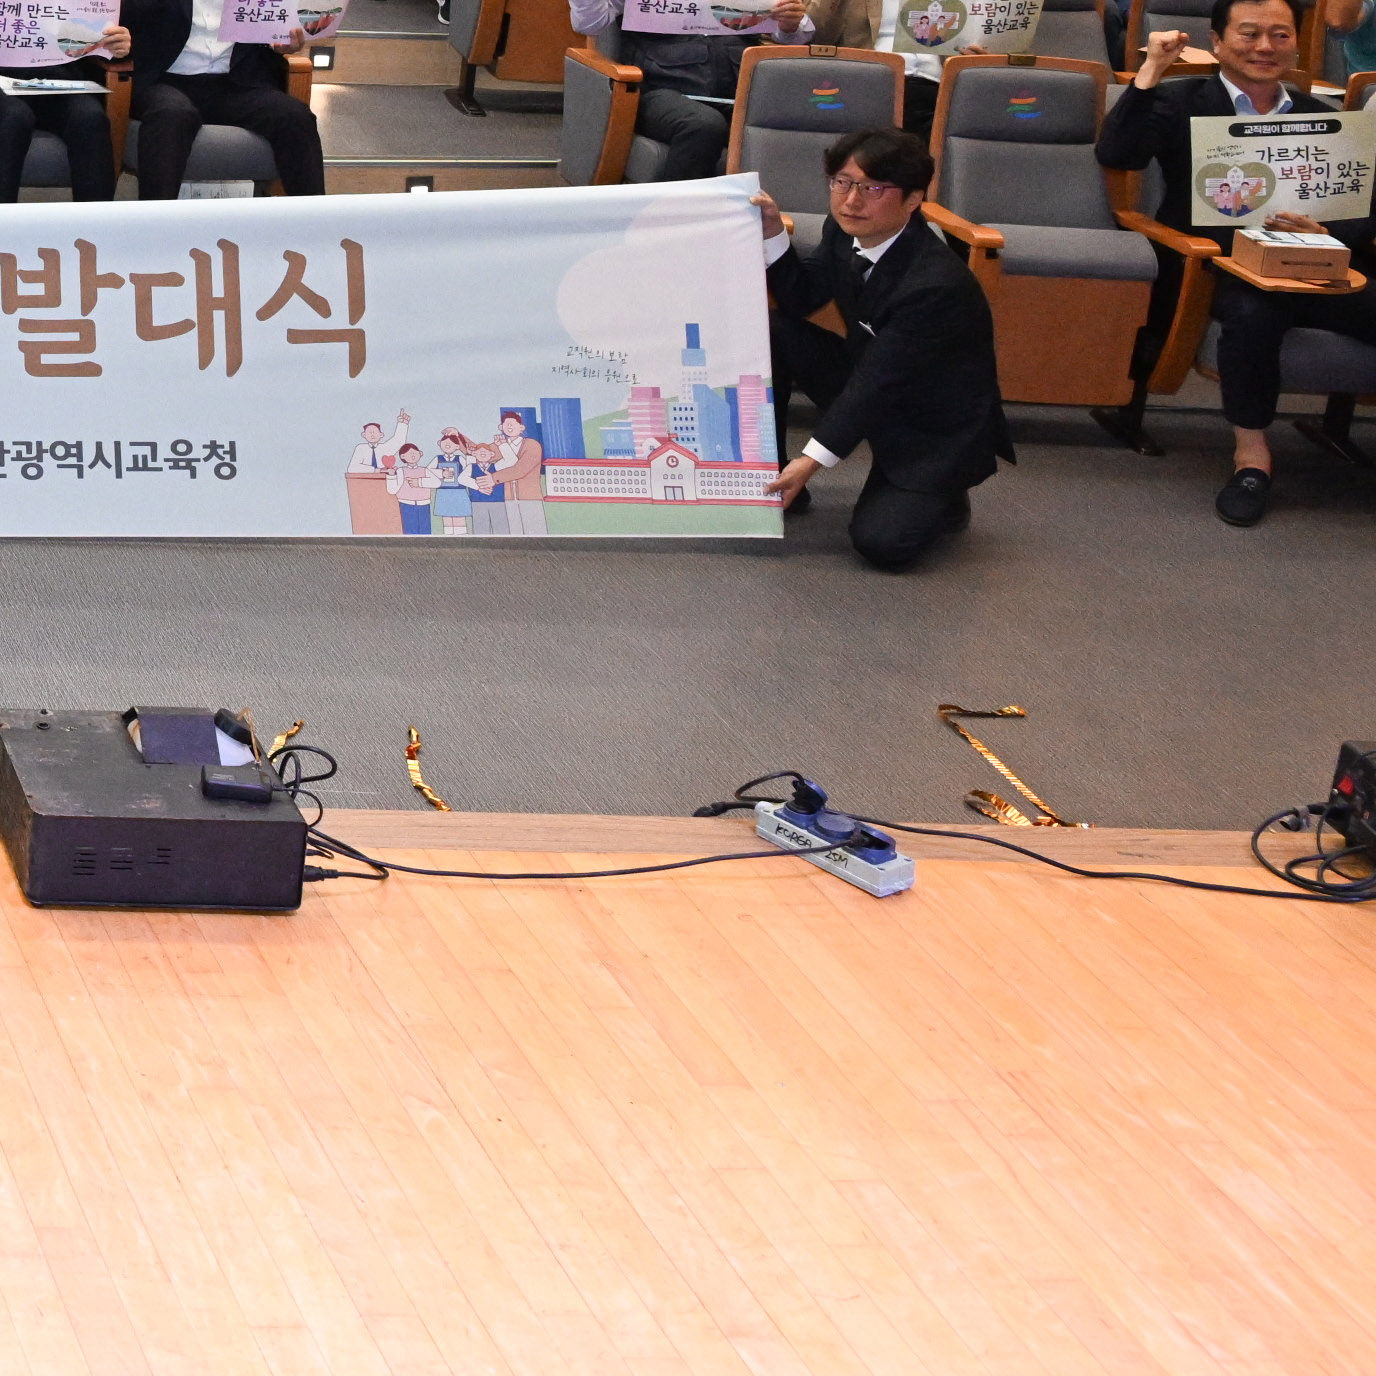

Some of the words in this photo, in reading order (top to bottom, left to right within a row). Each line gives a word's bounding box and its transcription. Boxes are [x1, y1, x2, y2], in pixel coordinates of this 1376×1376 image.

[1243, 124, 1280, 134] 교직원이
[1281, 122, 1327, 133] 함께합니다
[1255, 145, 1329, 165] 가르치는
[1277, 163, 1330, 180] 보람이
[1336, 160, 1370, 178] 있는
[1295, 178, 1364, 200] 울산교육
[566, 345, 604, 359] 교직원의
[609, 350, 628, 364] 보람
[551, 364, 600, 379] 지역사회의
[605, 368, 640, 384] 응원으로
